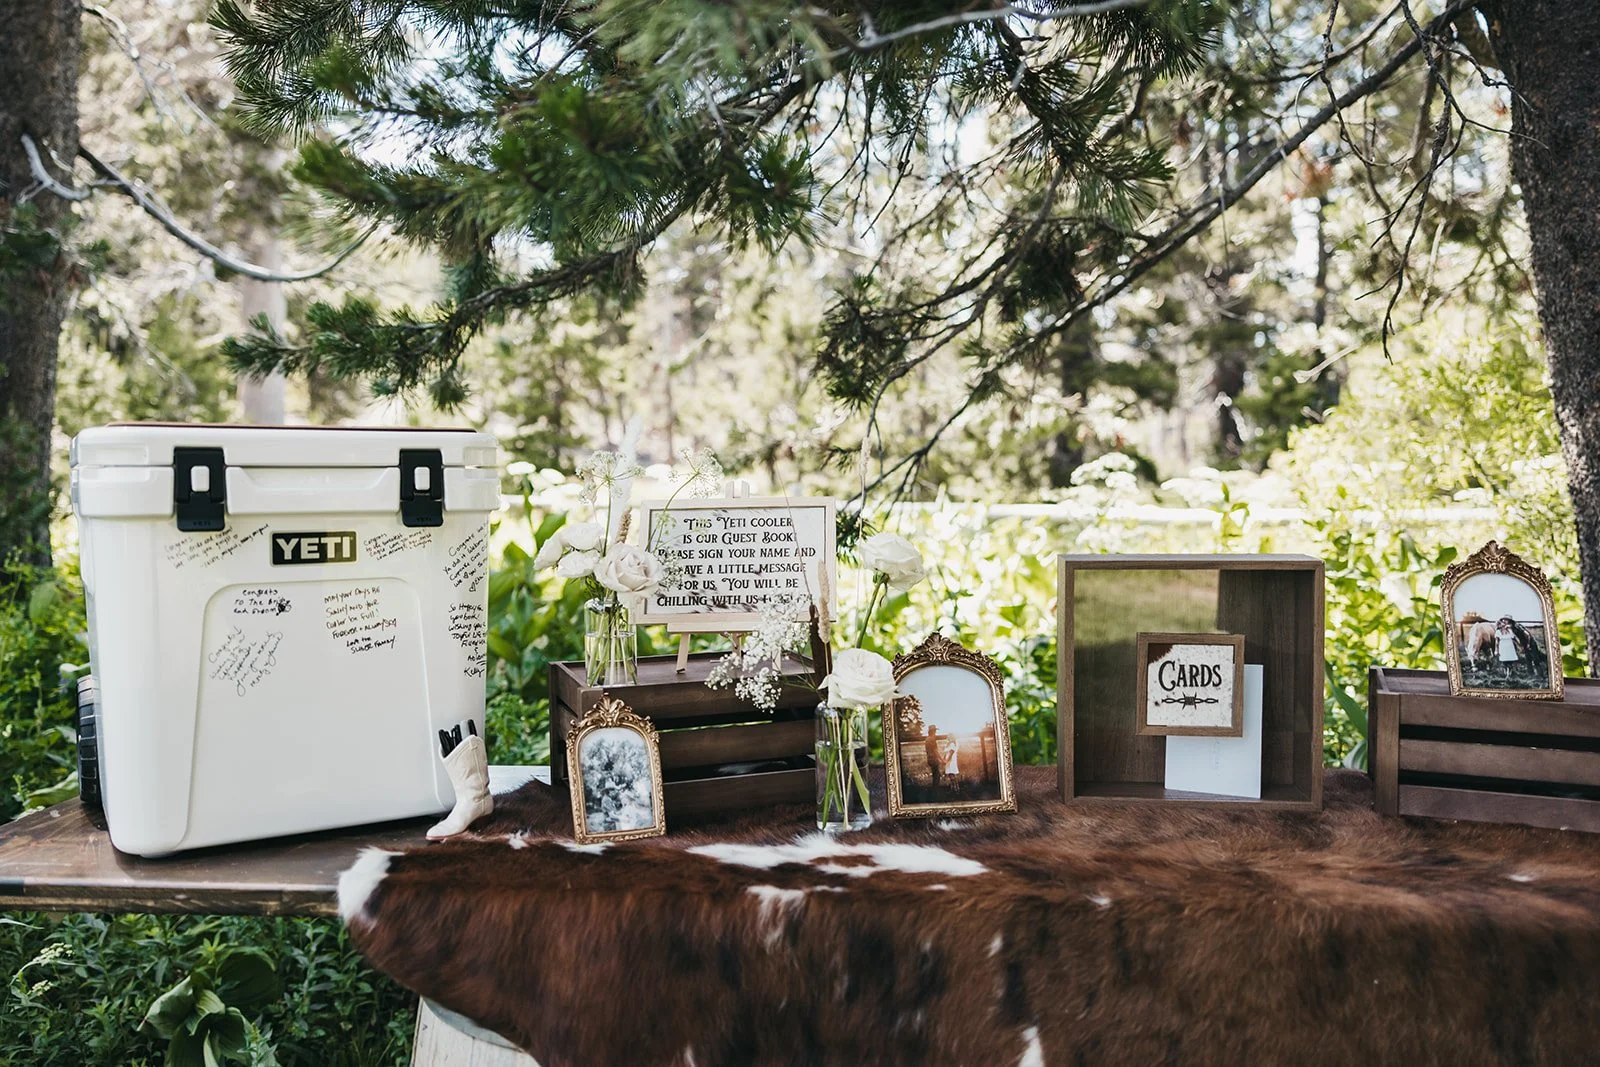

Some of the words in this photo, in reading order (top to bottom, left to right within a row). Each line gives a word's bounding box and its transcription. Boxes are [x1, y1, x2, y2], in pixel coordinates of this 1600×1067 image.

[716, 516, 746, 530] YETI
[750, 517, 793, 528] COOLER
[683, 534, 693, 545] IS
[696, 534, 718, 544] OUR
[721, 532, 757, 546] GUEST
[275, 536, 351, 560] YETI
[698, 549, 723, 559] SIGN
[728, 548, 756, 559] YOUR
[760, 547, 790, 558] NAME
[794, 547, 816, 557] AND
[706, 565, 714, 574] A
[718, 564, 755, 574] LITTLE
[760, 562, 807, 574] MESSAGE
[721, 578, 750, 591] YOU
[786, 578, 799, 589] BE
[657, 595, 708, 607] CHILLING
[711, 594, 741, 606] WITH
[745, 594, 759, 605] US
[1158, 660, 1222, 691] CARDS
